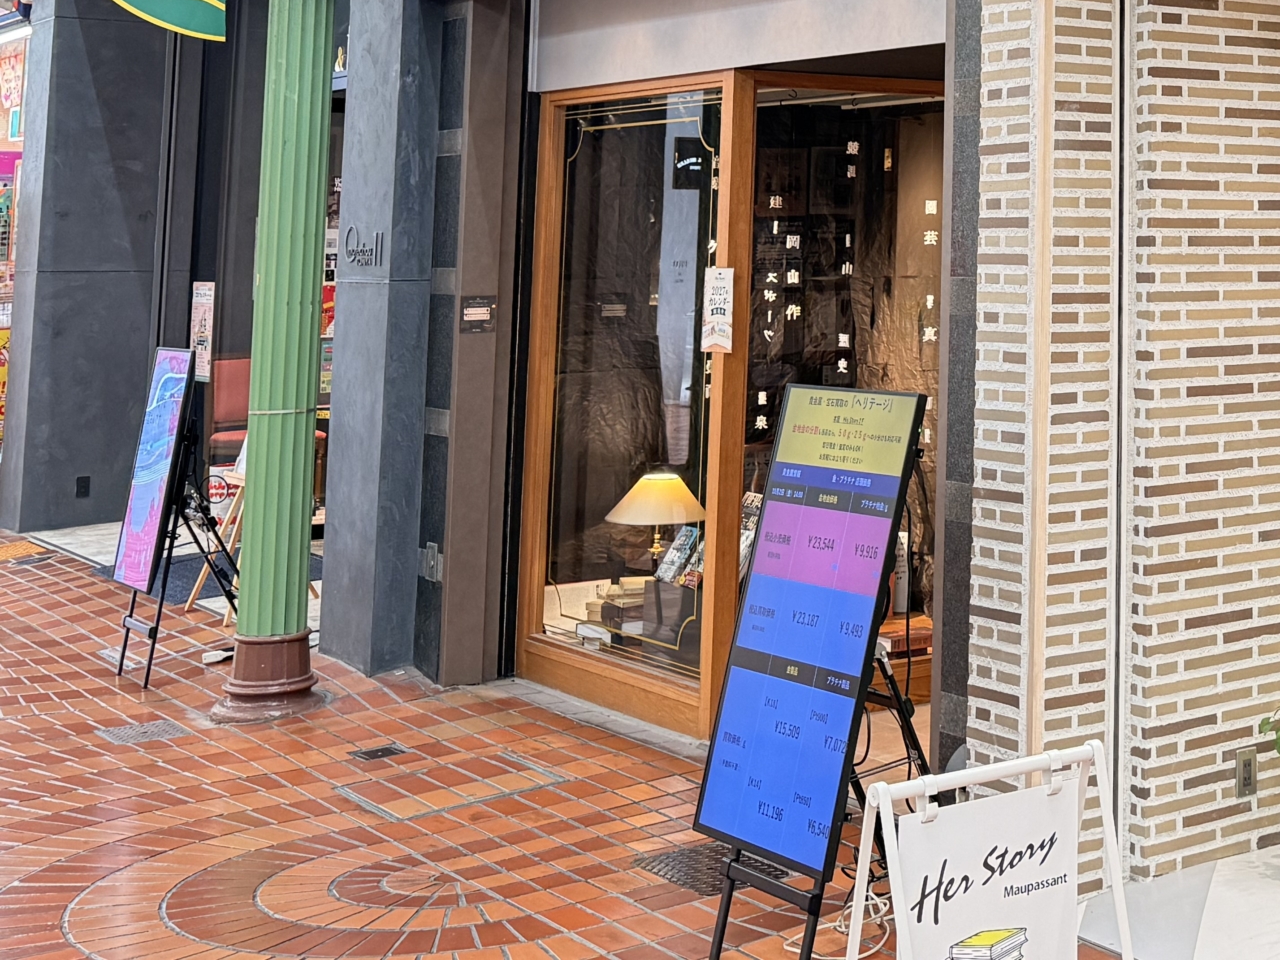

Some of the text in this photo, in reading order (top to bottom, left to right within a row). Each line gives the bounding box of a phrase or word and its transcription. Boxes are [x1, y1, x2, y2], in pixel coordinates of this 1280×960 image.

[709, 297, 730, 307] カレンダー
[808, 535, 835, 552] ¥23,544
[854, 542, 879, 560] ¥9,916
[792, 610, 820, 628] ¥23,187
[839, 620, 864, 639] ¥9,493
[774, 720, 802, 740] ¥15,509
[757, 800, 785, 822] ¥11,196
[910, 830, 1058, 926] Her Story
[1003, 872, 1069, 899] Maupassant
